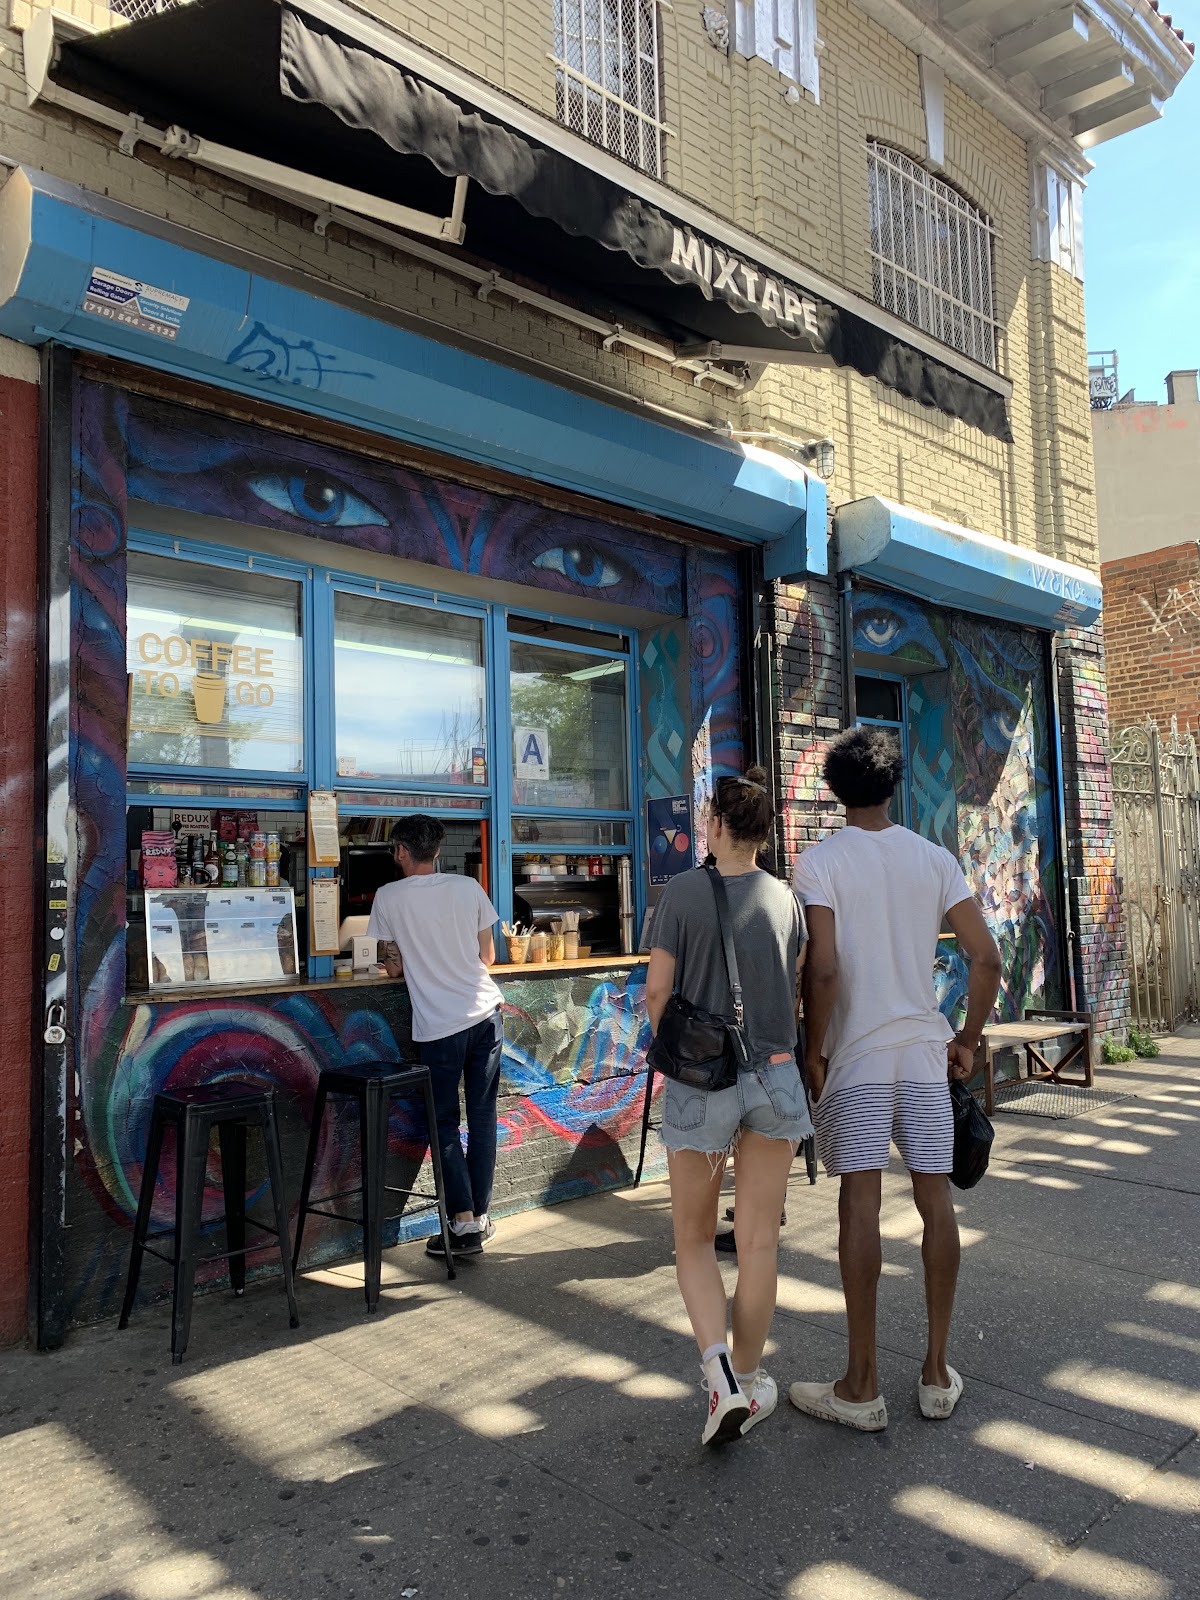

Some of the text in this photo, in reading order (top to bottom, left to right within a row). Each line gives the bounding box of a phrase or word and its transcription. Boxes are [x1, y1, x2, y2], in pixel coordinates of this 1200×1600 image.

[92, 278, 134, 297] Garage Doors
[671, 227, 819, 336] MIXTAPE
[89, 285, 126, 302] Rolling Gates
[140, 298, 160, 310] Security
[160, 304, 183, 317] Solutions
[143, 306, 160, 316] Doors
[83, 301, 115, 319] (718)
[117, 313, 139, 326] 544
[148, 323, 176, 338] 2133
[139, 632, 274, 677] COFFEE
[139, 669, 274, 707] TO GO
[521, 733, 543, 765] A
[174, 813, 209, 823] REDUX
[145, 847, 172, 857] REDUX
[935, 1396, 949, 1409] AP
[869, 1408, 885, 1423] AP
